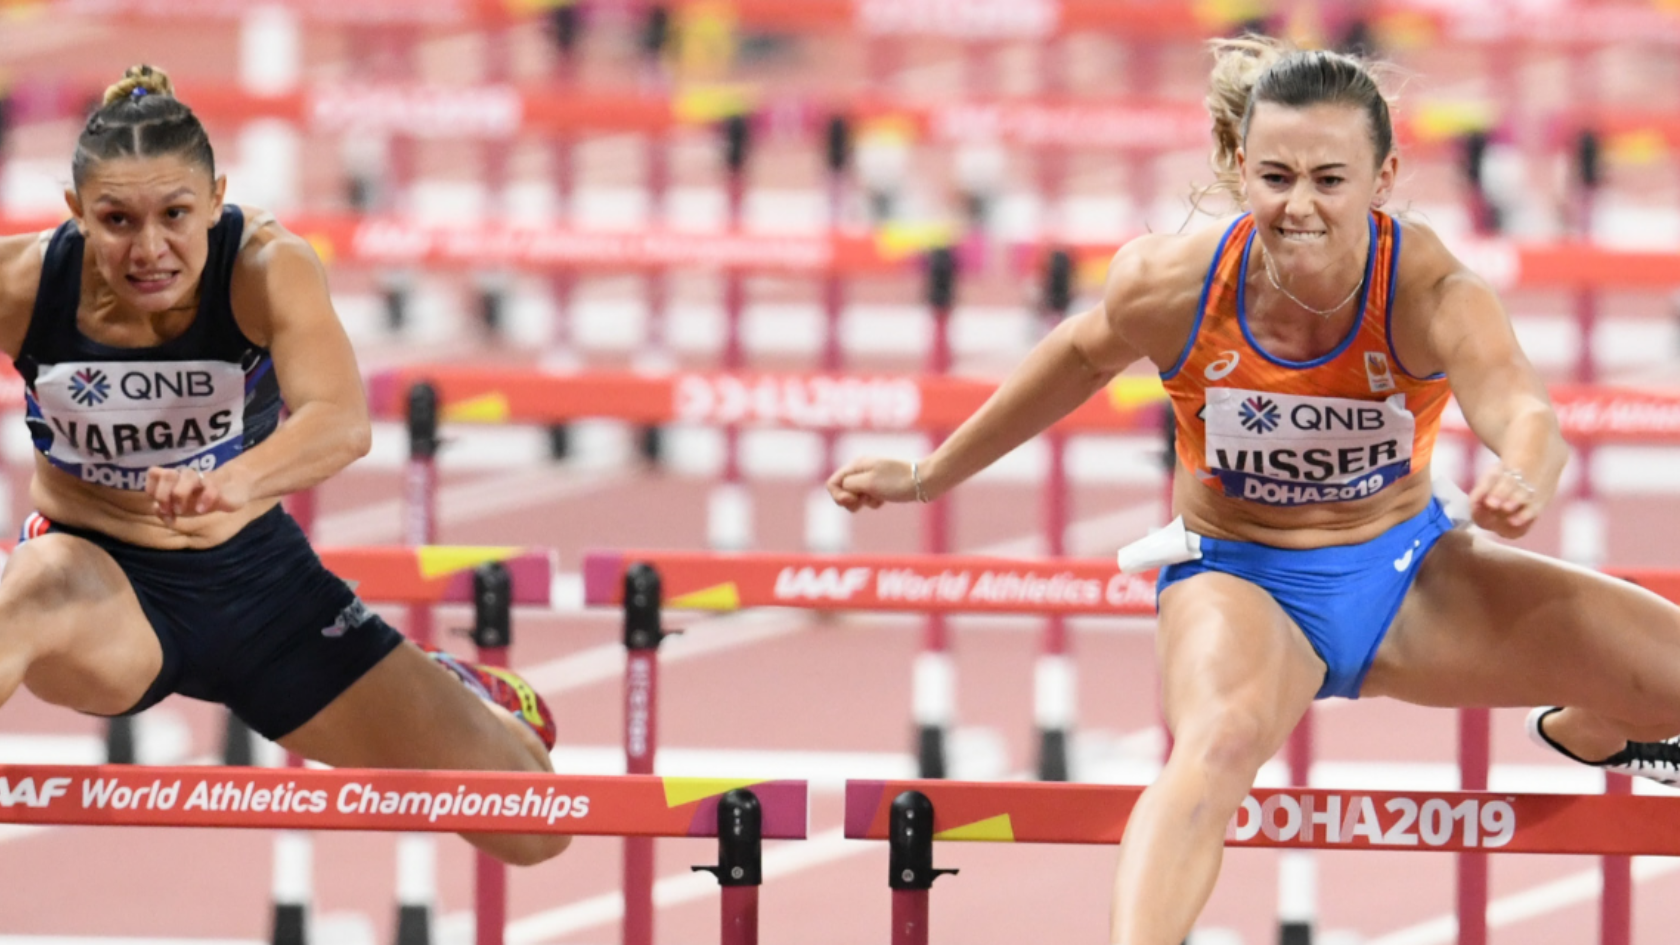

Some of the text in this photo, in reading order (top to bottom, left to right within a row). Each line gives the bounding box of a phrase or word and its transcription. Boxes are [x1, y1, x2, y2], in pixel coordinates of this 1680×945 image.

[120, 370, 214, 400] QNB
[52, 409, 232, 461] VARGAS
[1290, 403, 1385, 431] QNB
[1216, 439, 1398, 482] VISSER
[1243, 473, 1384, 504] DOHA2019
[774, 566, 871, 600] IAAF
[876, 568, 970, 601] World
[969, 570, 1100, 604] Athletics
[82, 778, 181, 811] World
[184, 782, 327, 815] Athletics
[336, 782, 590, 824] Championships
[1225, 793, 1516, 847] DOHA2019
